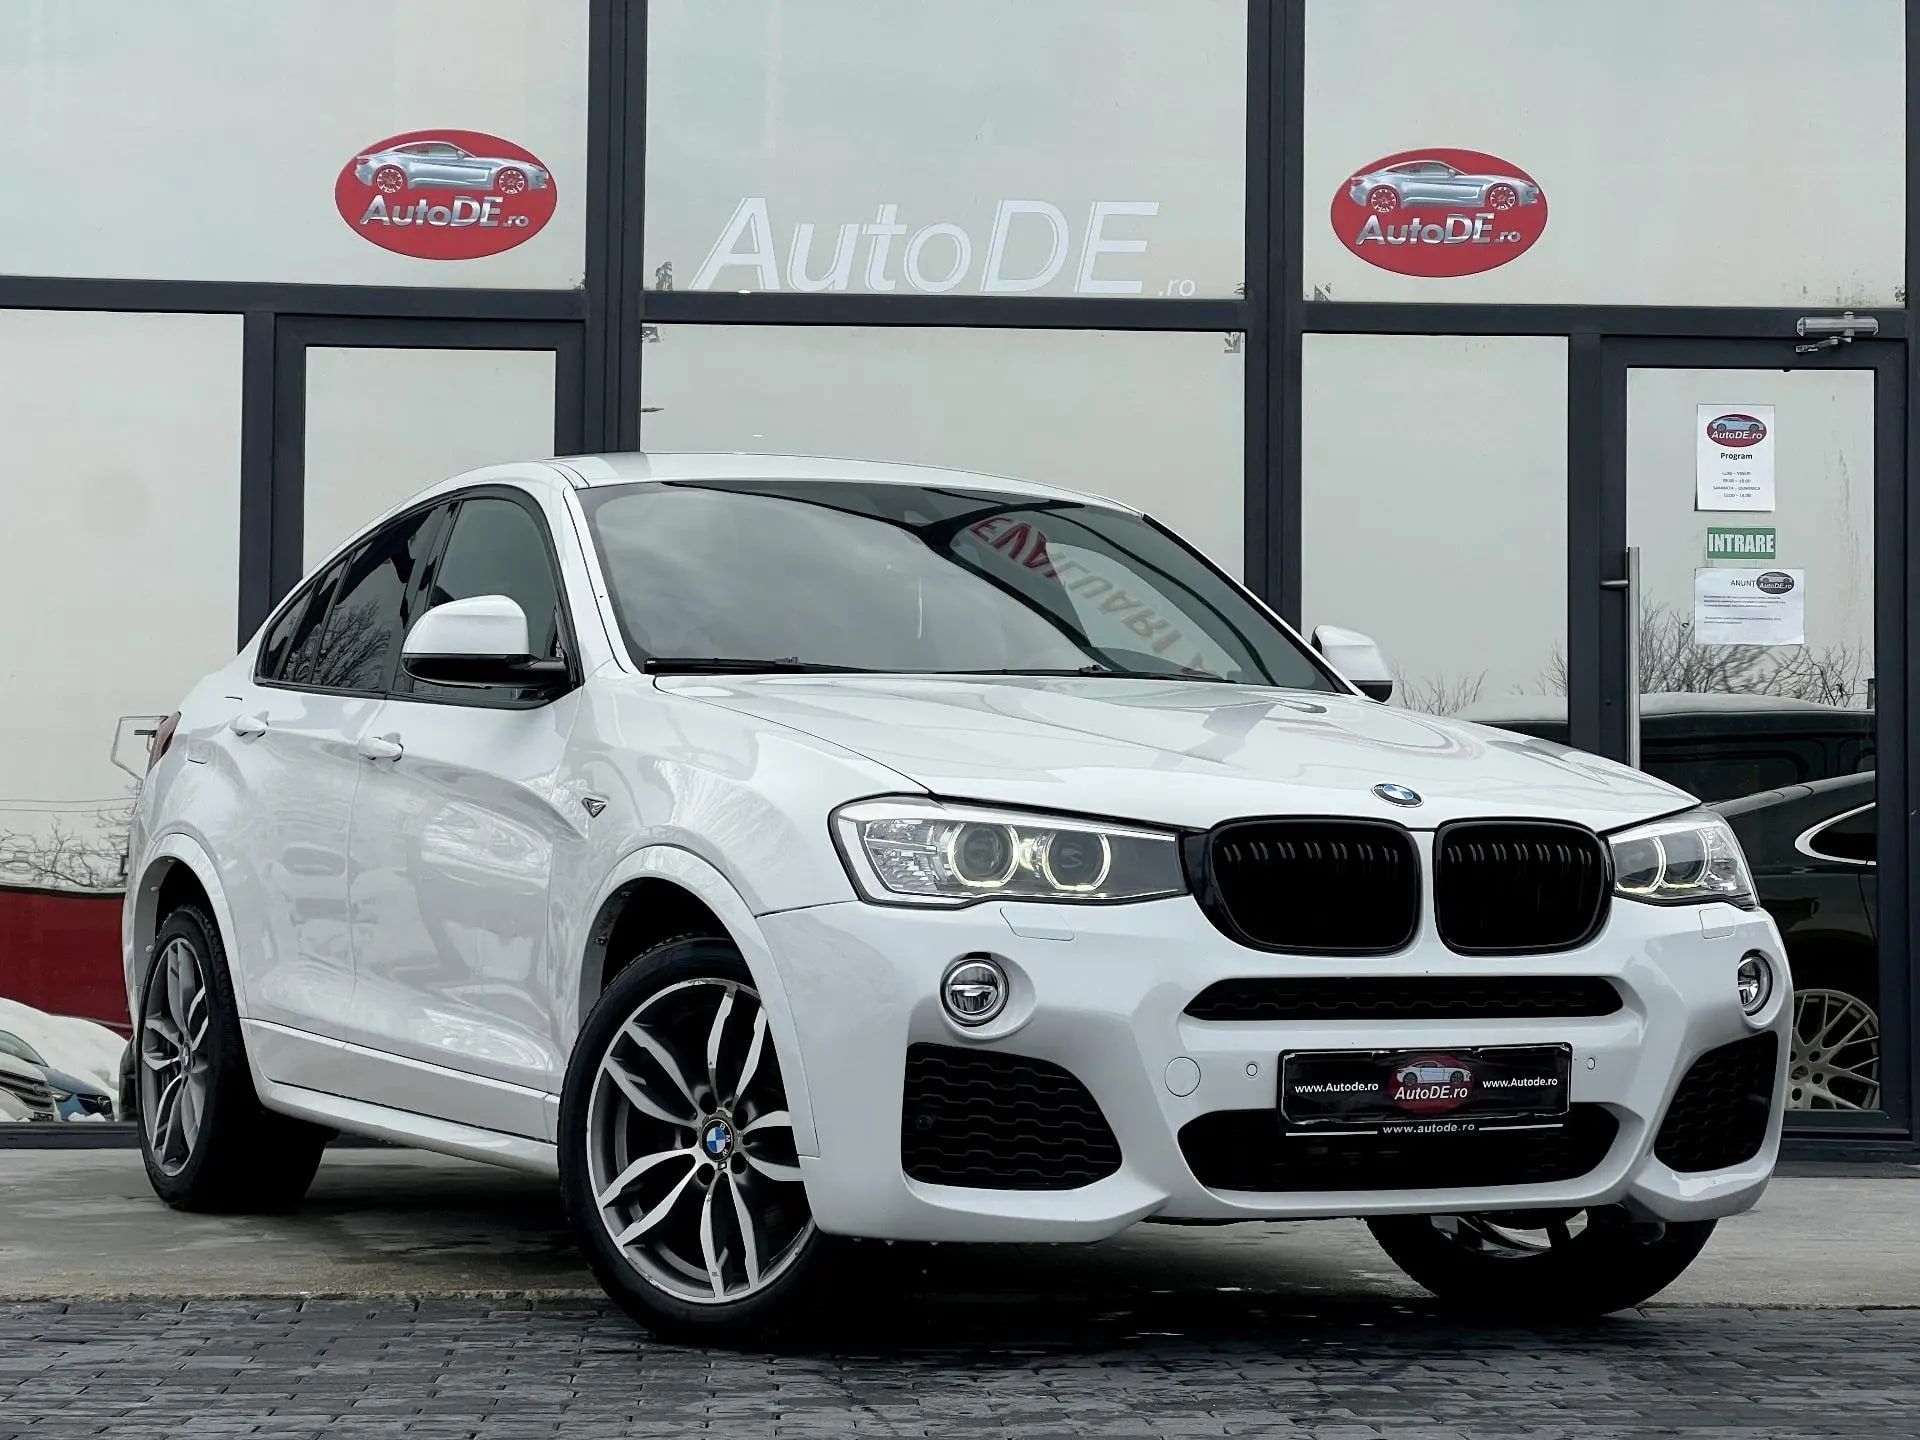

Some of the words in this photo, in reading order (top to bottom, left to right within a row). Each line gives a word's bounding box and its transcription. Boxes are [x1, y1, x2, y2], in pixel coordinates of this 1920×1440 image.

[360, 194, 529, 228] AutoDE.ro
[1355, 212, 1522, 246] AutoDE.ro
[688, 197, 1196, 297] AutoDE.ro
[1711, 430, 1763, 440] AutoDE.ro
[1720, 452, 1753, 461] Program
[1708, 533, 1775, 553] INTRARE
[1294, 1081, 1380, 1094] www.Autode.ro
[1482, 1076, 1559, 1089] www.Autode.ro
[1394, 1085, 1469, 1101] AutoDE.ro
[1382, 1122, 1476, 1134] www.autode.ro
